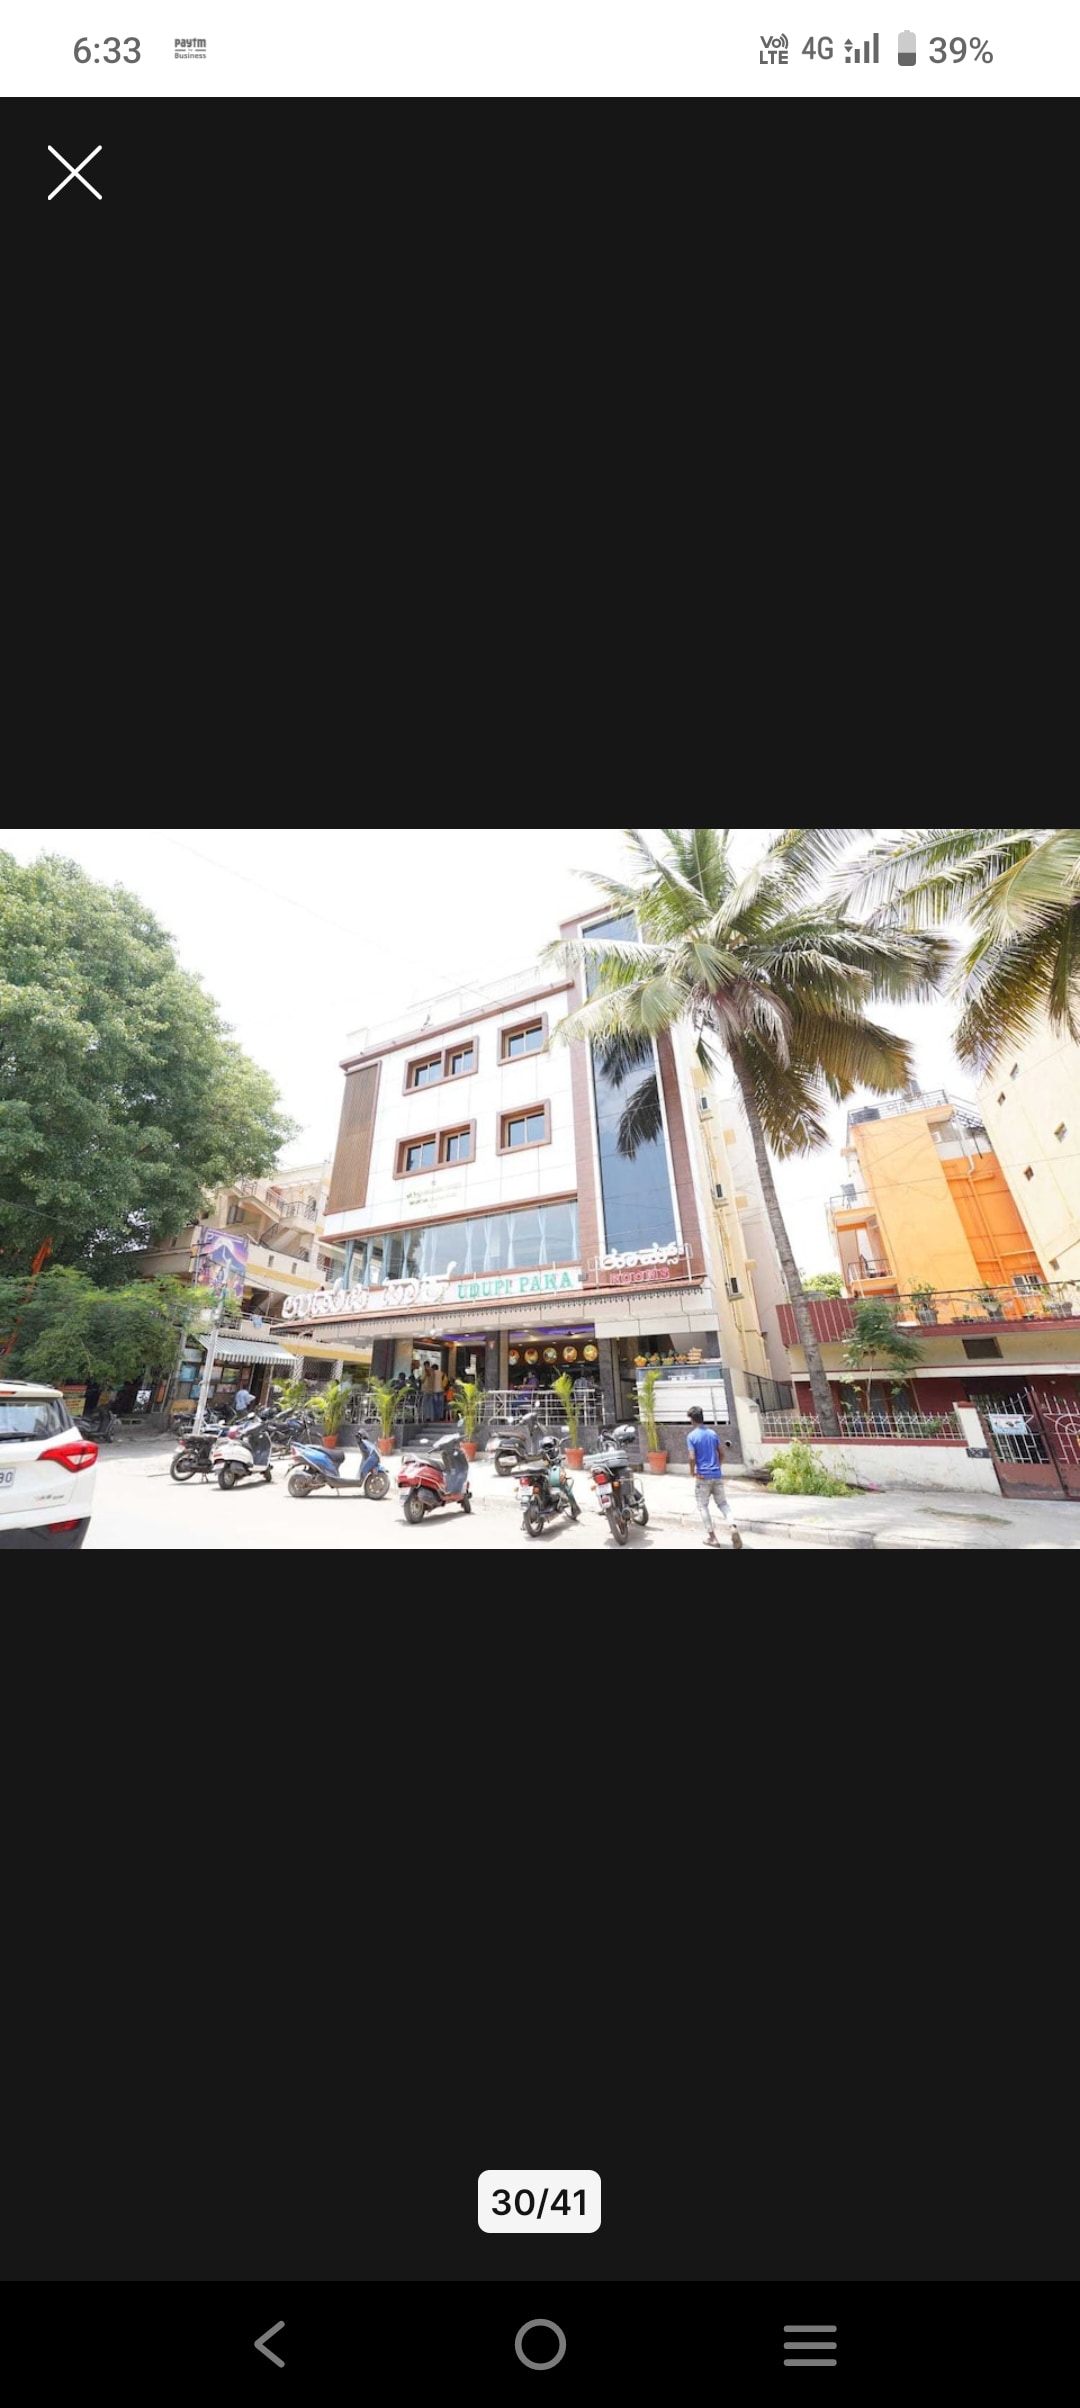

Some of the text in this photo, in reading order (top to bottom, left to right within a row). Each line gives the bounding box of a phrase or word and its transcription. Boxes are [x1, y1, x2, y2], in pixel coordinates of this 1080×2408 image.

[457, 1271, 574, 1300] UDUPI PAKA
[610, 1266, 670, 1285] ROOMS
